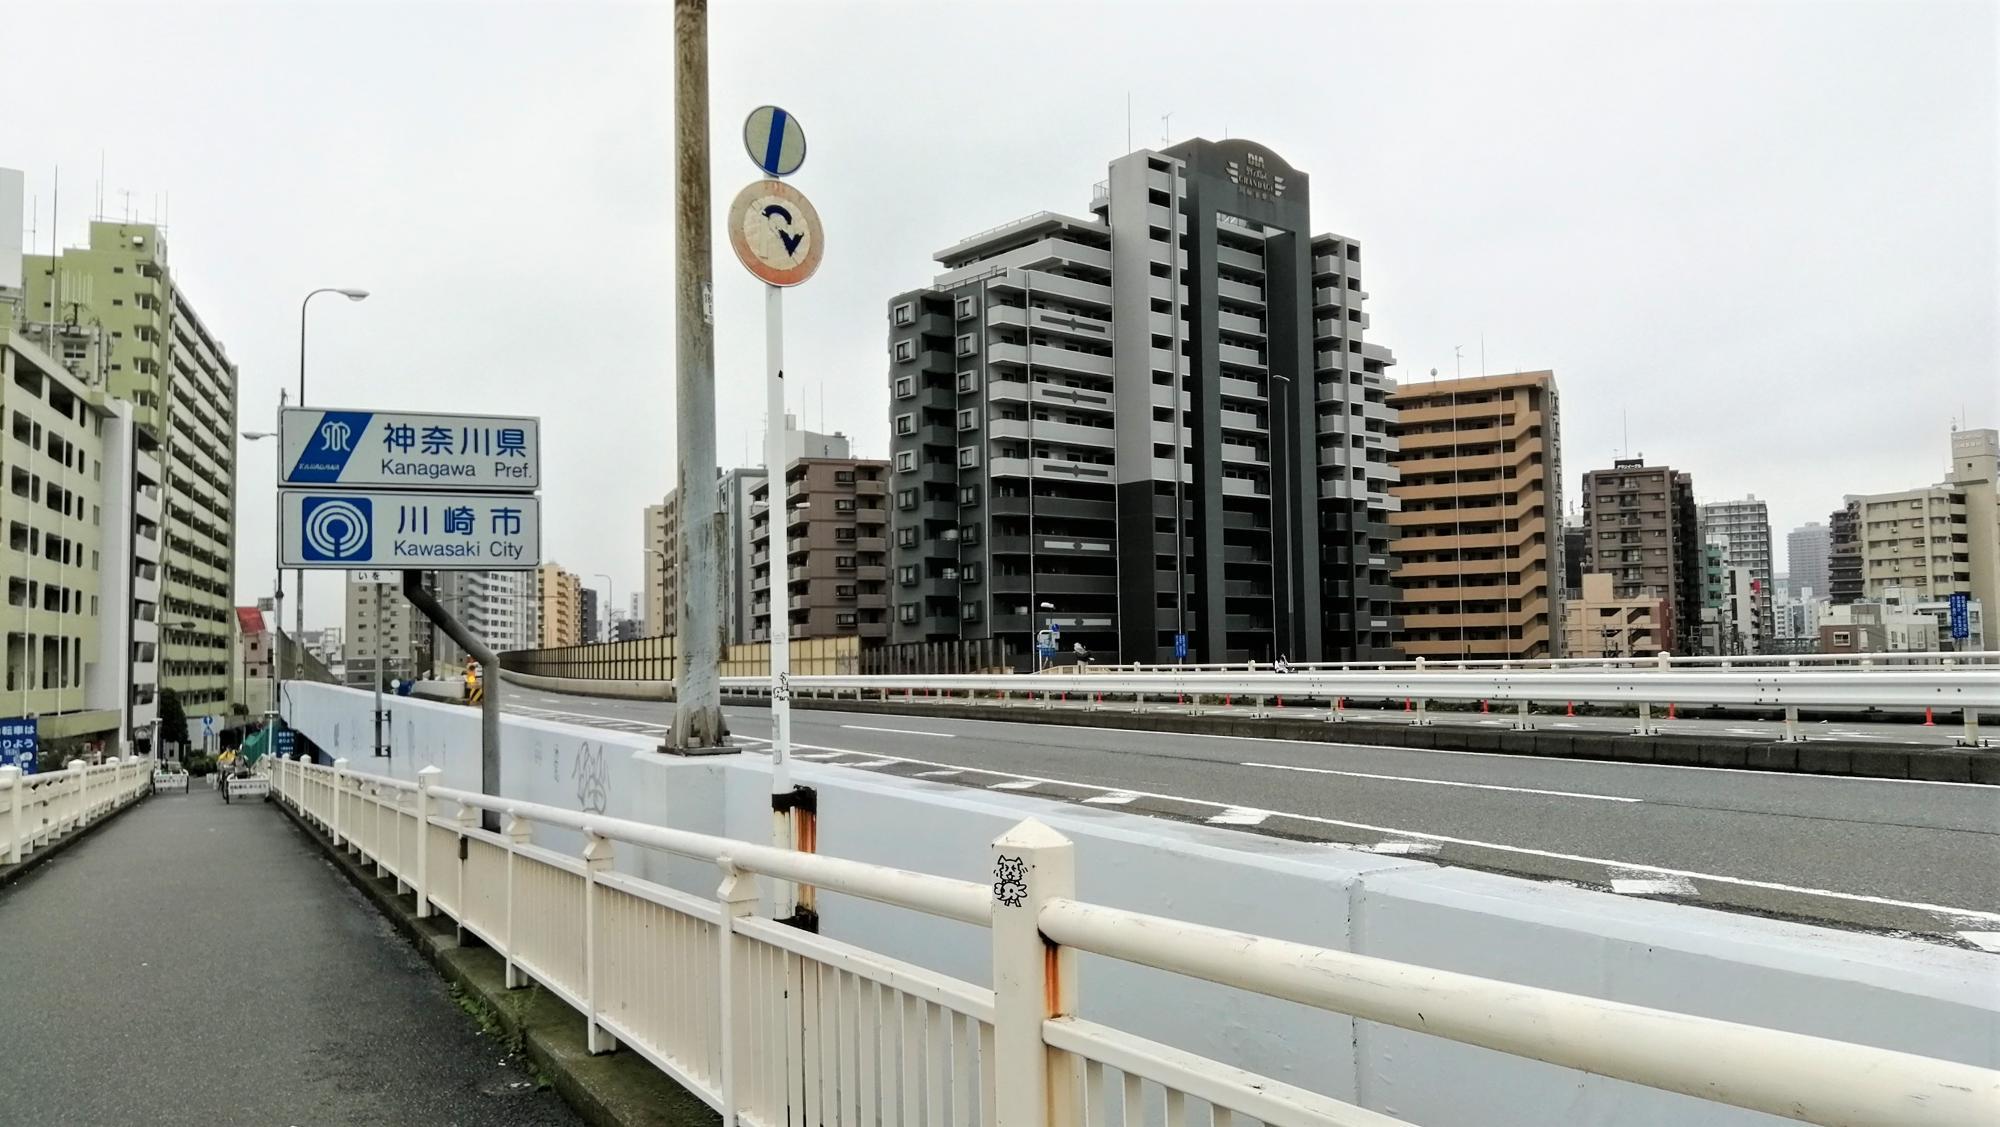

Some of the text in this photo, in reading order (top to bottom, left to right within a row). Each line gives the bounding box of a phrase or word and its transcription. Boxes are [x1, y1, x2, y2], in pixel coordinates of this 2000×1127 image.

[382, 422, 527, 458] 神奈川県
[381, 458, 533, 480] Kanagawa Pref.
[397, 505, 522, 537] 川崎市
[394, 540, 523, 561] Kawasaki City
[0, 725, 35, 736] 転車は
[0, 738, 34, 749] りよう
